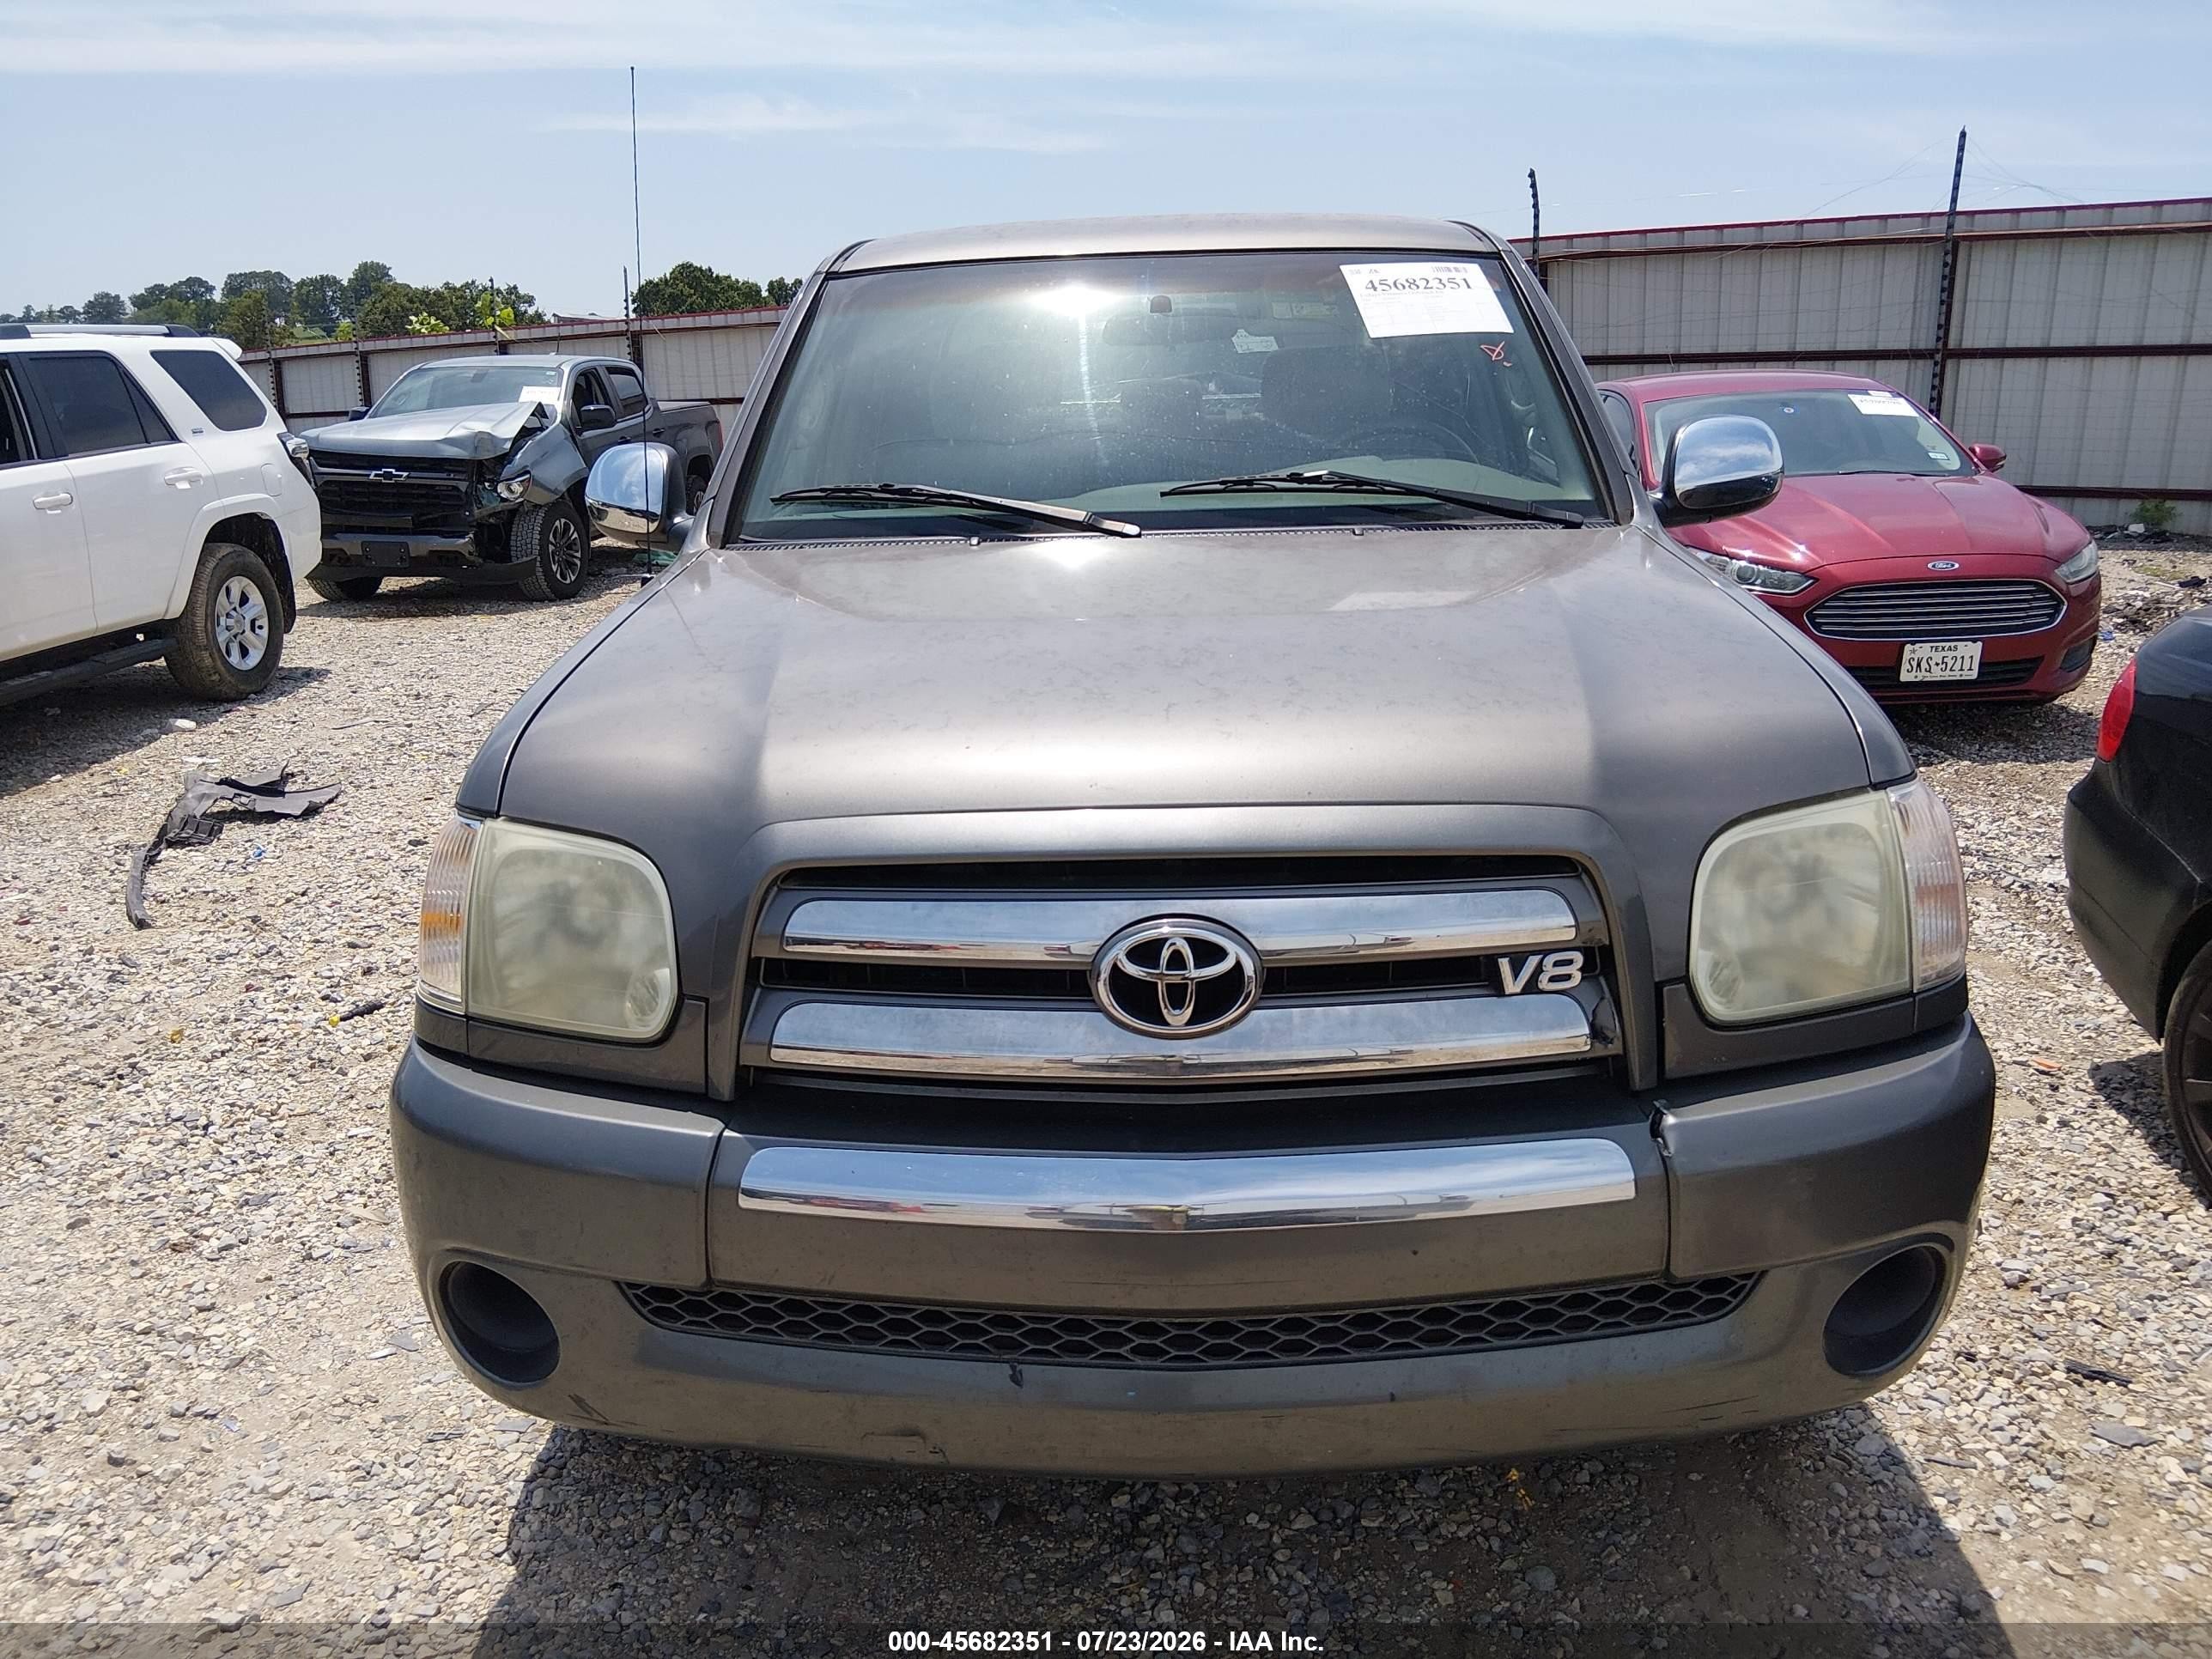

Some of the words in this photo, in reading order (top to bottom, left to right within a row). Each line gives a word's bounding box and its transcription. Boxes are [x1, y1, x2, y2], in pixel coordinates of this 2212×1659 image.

[1364, 276, 1473, 292] 45682351
[1929, 644, 1959, 653] TEXAS
[1498, 951, 1584, 994] V8
